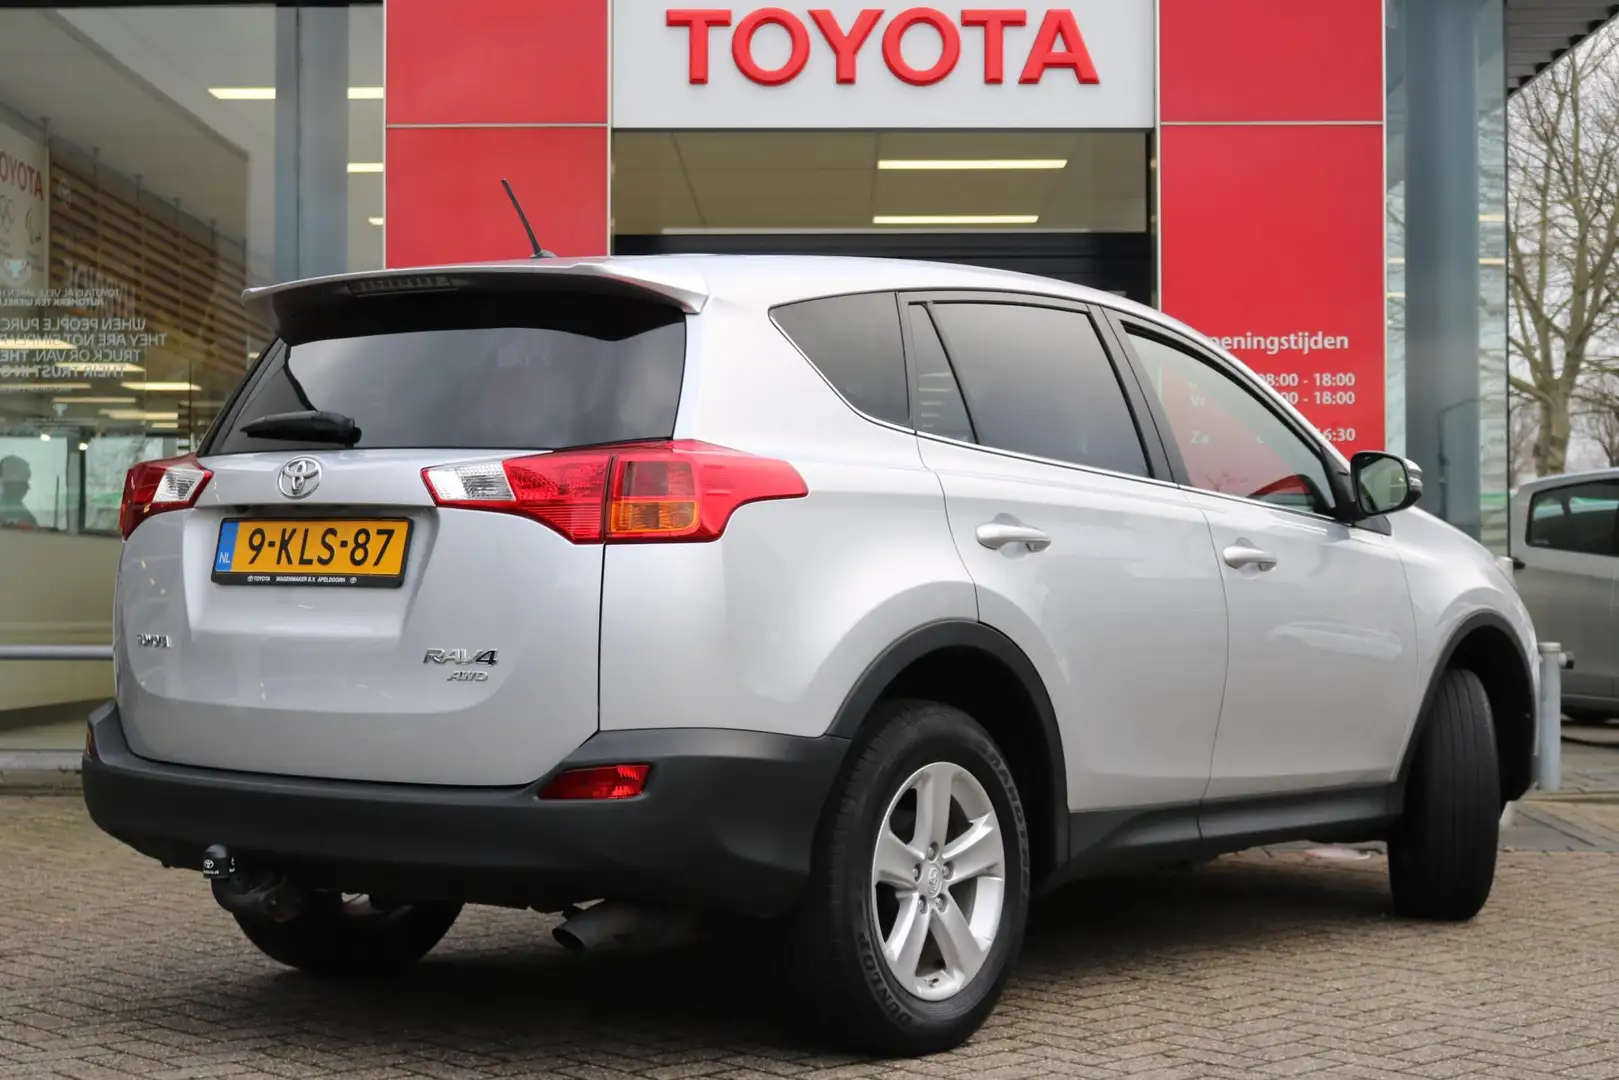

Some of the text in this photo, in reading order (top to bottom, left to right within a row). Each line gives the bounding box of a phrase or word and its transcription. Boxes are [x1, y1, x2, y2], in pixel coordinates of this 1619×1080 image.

[666, 7, 1101, 87] TOYOTA
[1314, 373, 1356, 386] 18:00
[1314, 391, 1356, 404] 18:00
[1317, 428, 1356, 441] 6:30
[247, 527, 396, 567] 9-KLS-87
[218, 551, 231, 564] NL
[423, 647, 498, 667] RAV4
[446, 670, 489, 682] AWD
